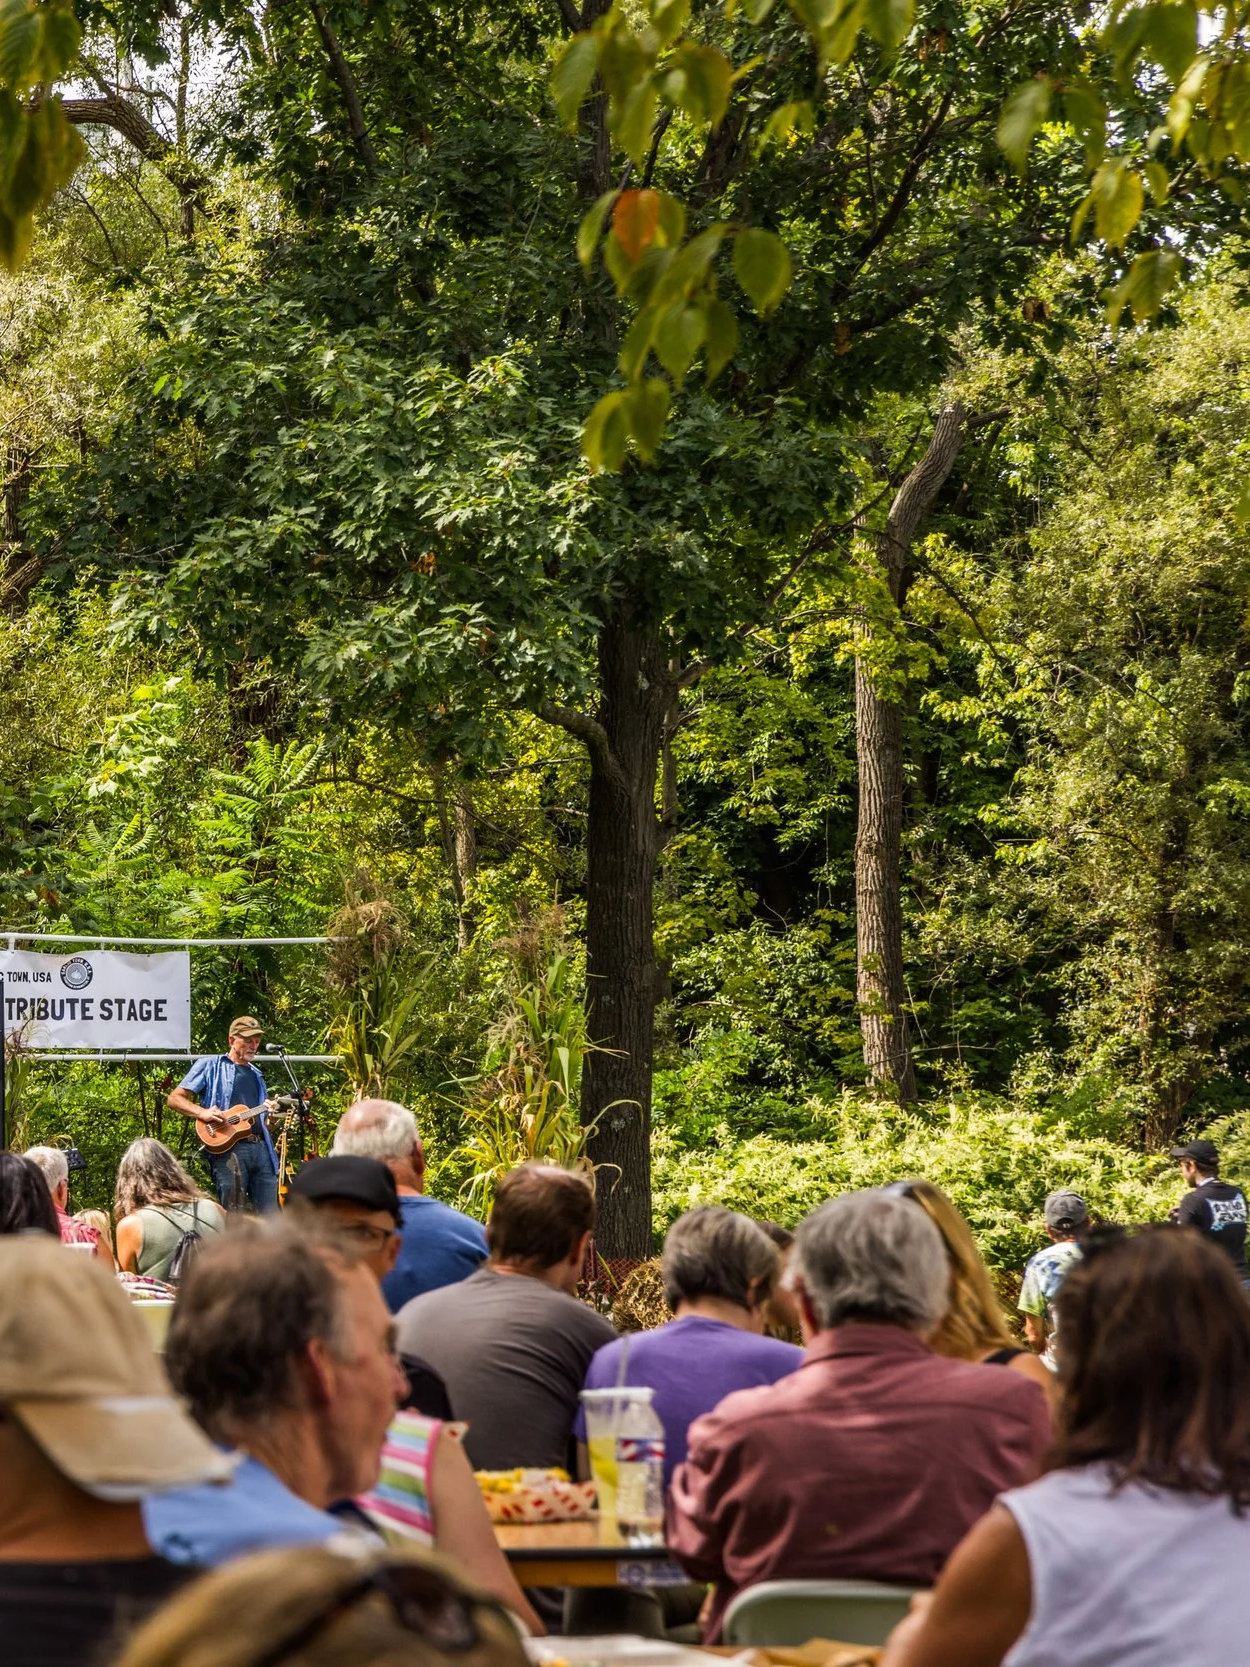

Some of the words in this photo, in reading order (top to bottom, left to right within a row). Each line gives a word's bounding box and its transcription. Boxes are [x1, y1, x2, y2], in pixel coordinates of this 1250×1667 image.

[6, 971, 31, 984] TOWN,
[32, 971, 52, 983] USA
[4, 997, 94, 1021] TRIBUTE
[99, 998, 168, 1022] STAGE
